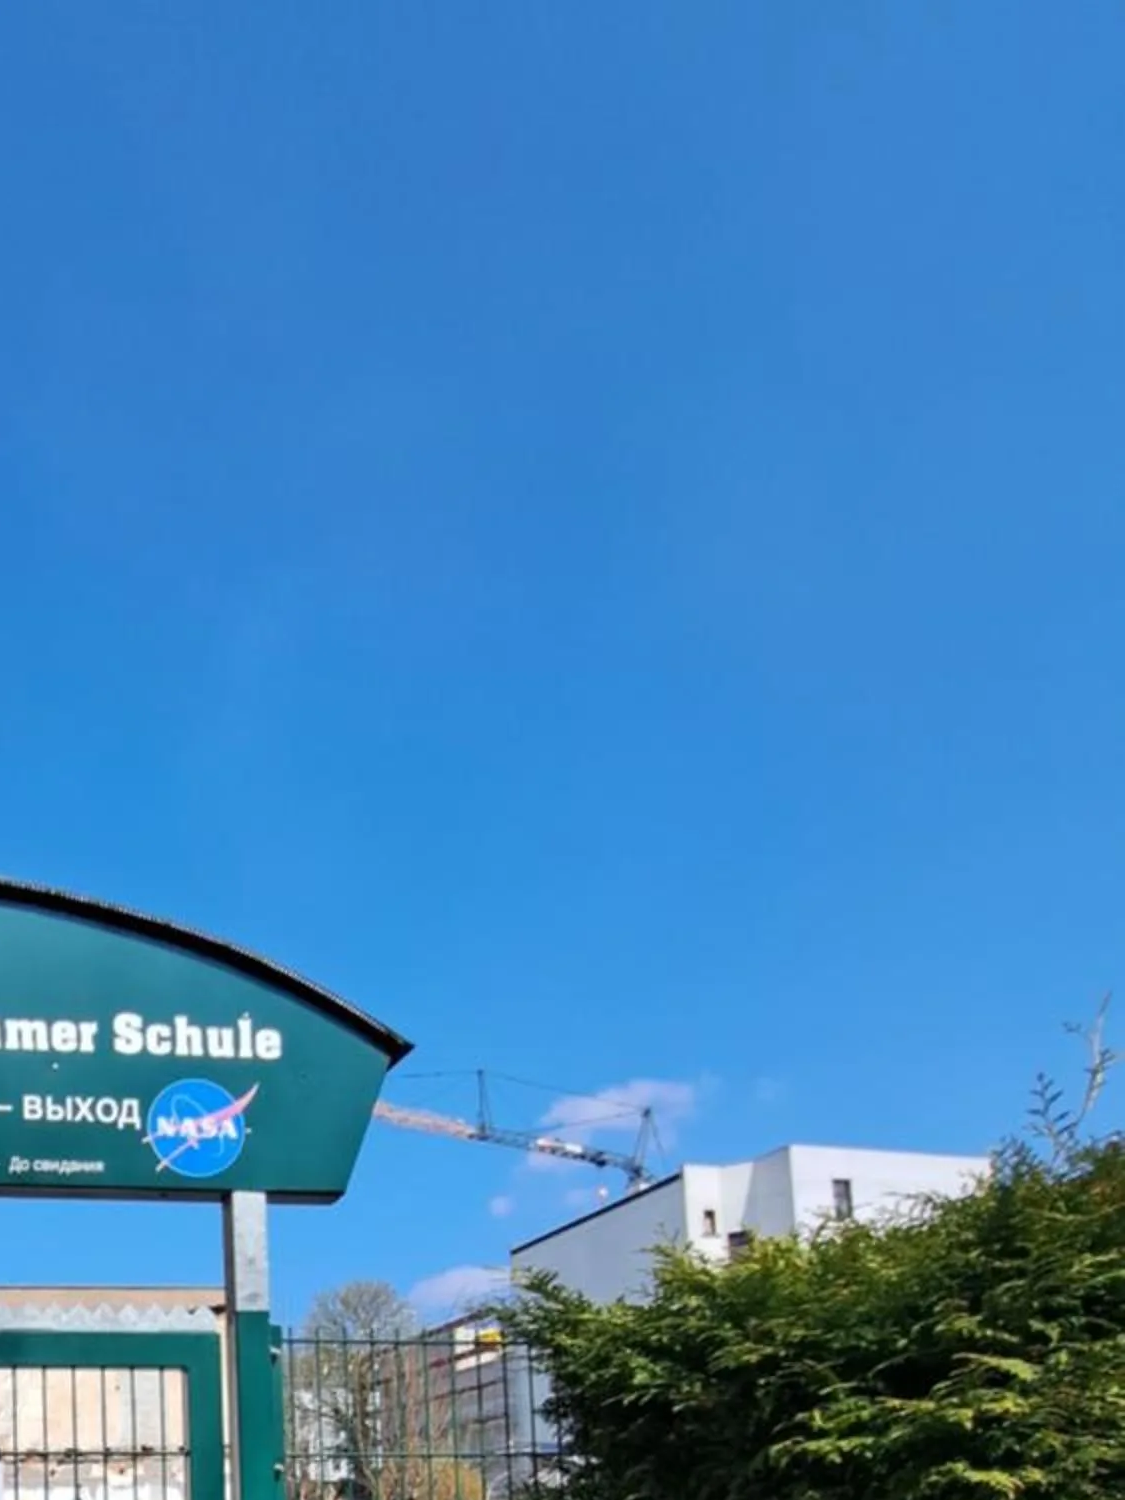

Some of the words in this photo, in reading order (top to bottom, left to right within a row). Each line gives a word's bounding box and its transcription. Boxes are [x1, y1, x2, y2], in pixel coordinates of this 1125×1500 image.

[112, 1013, 282, 1060] Schule
[22, 1095, 141, 1129] ВЫХОД
[156, 1116, 237, 1139] NASA
[8, 1156, 30, 1173] До
[32, 1159, 106, 1175] свидания
